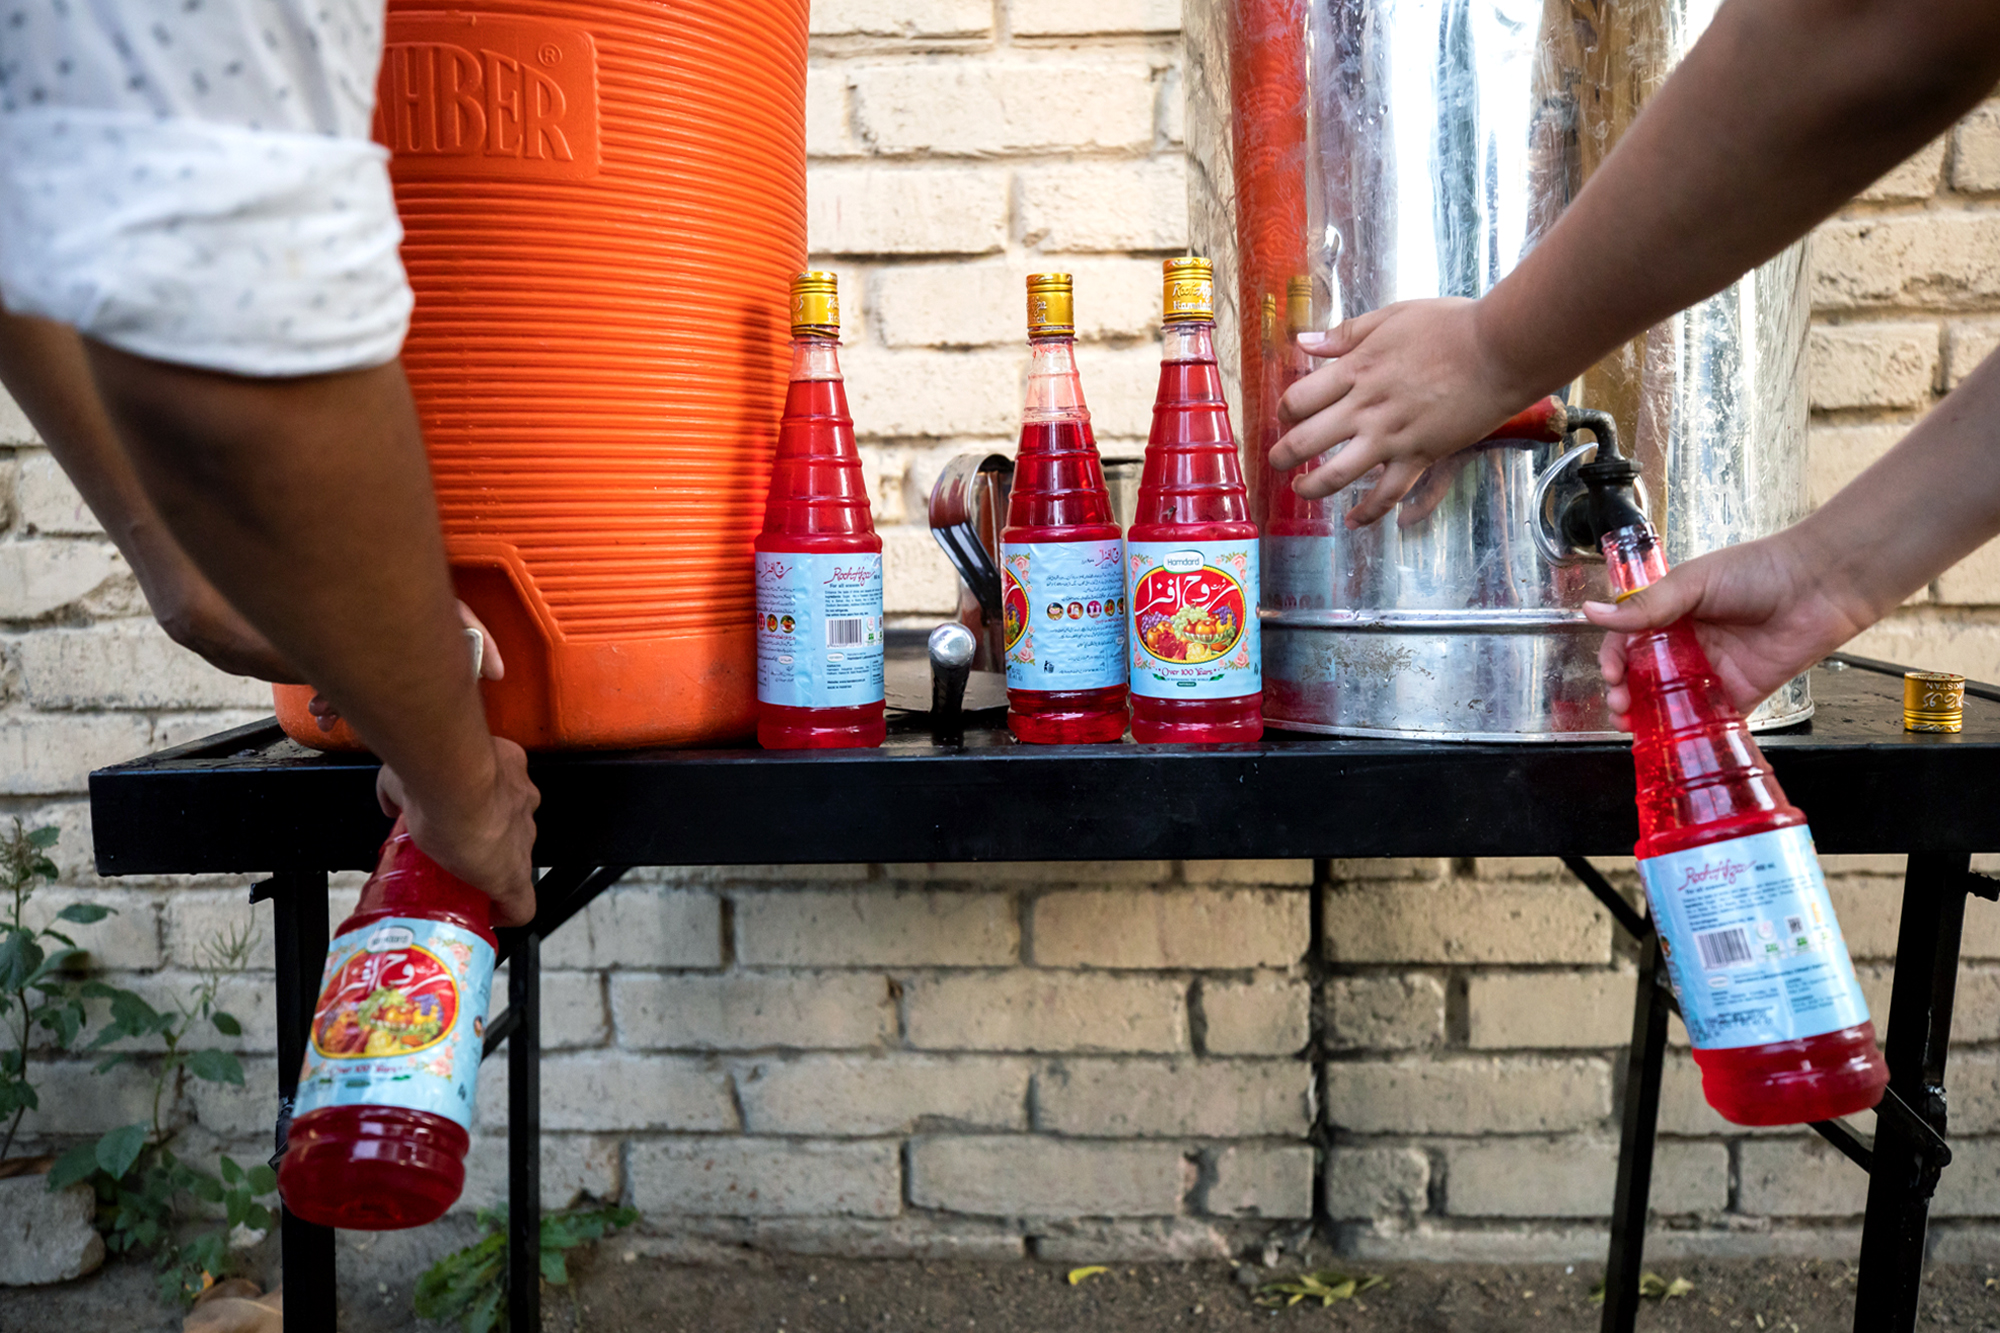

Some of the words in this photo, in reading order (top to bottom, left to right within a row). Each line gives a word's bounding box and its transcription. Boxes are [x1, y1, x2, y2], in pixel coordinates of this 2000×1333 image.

[372, 42, 574, 161] HBER
[1167, 557, 1200, 567] Hamdard
[1135, 575, 1181, 616] افزا
[1181, 575, 1238, 612] روح
[1161, 667, 1179, 677] Over
[1181, 668, 1194, 676] 100
[1195, 667, 1213, 676] Years
